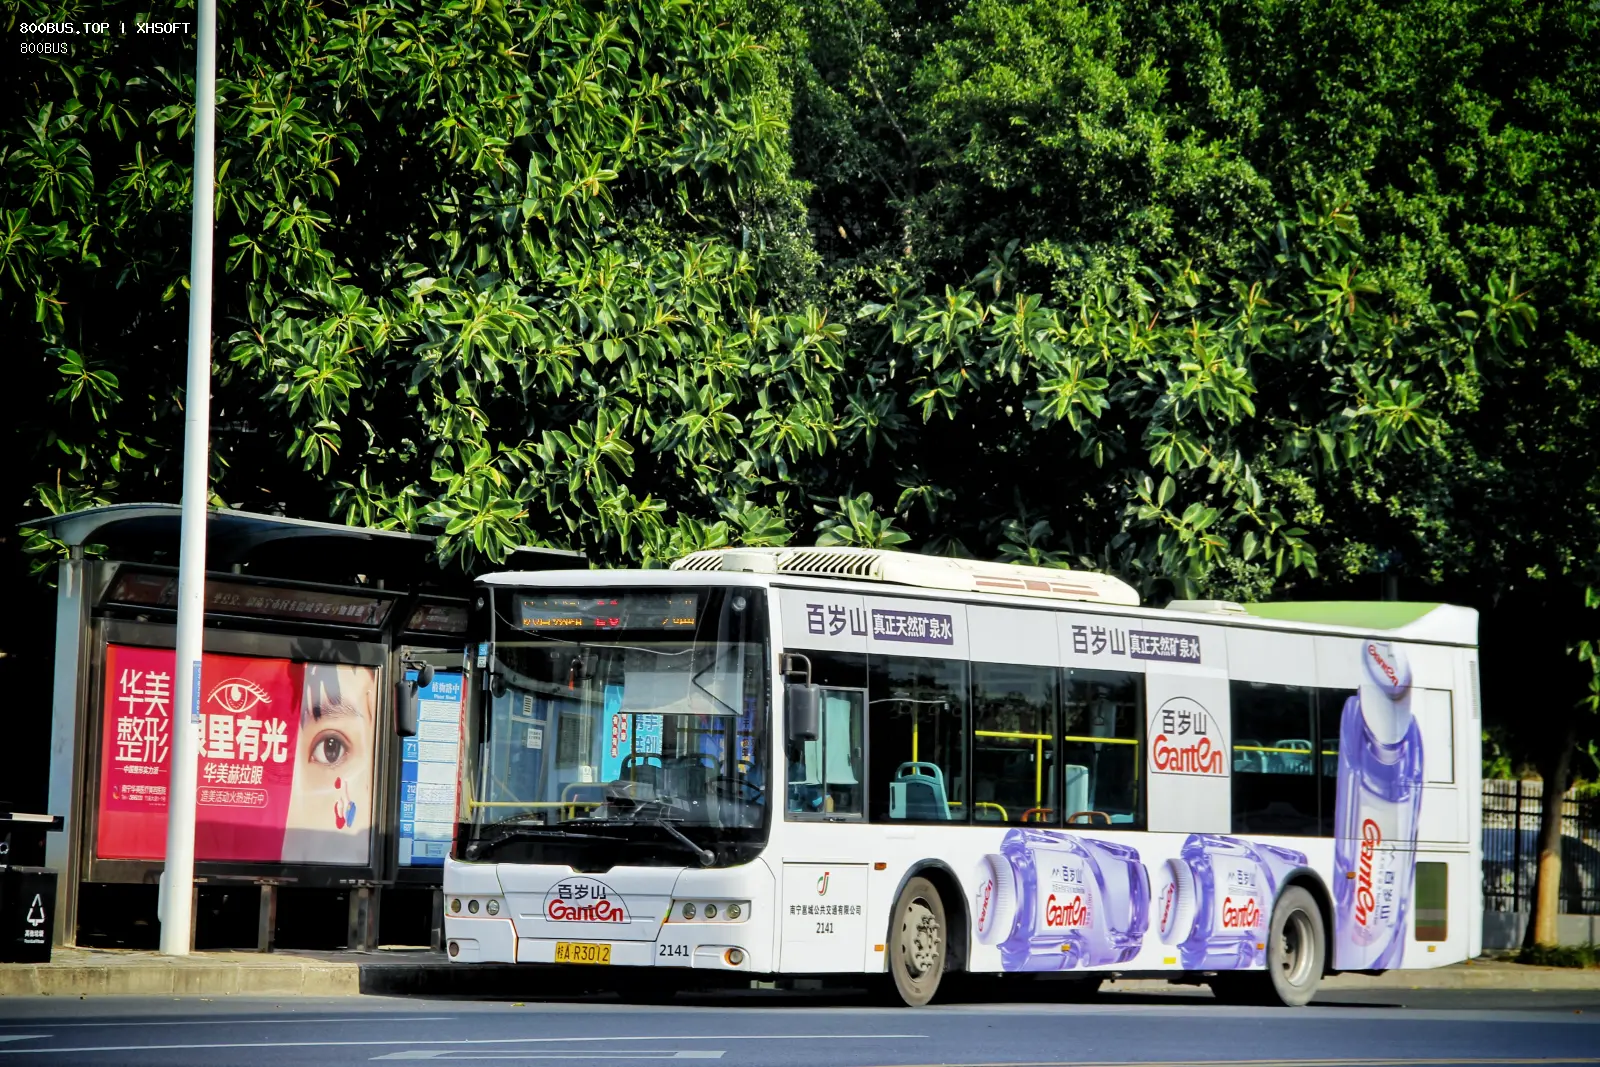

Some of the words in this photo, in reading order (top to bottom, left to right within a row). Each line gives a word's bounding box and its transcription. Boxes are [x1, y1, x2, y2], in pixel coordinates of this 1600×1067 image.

[806, 603, 869, 637] 百岁山
[873, 613, 953, 640] 真正天然矿泉水
[1071, 624, 1127, 656] 百岁山
[1130, 634, 1200, 659] 真正天然矿泉水
[118, 668, 171, 717] 华美
[1162, 709, 1207, 736] 百岁山
[114, 715, 170, 764] 整形
[407, 743, 417, 752] 71
[1153, 734, 1223, 774] Ganten
[203, 762, 264, 785] 华美赫拉眼
[1356, 818, 1382, 926] Ganten
[558, 884, 607, 900] 百岁山
[548, 899, 624, 922] Ganten
[1046, 893, 1087, 927] Ganten
[1222, 896, 1260, 928] Ganten
[816, 922, 834, 934] 2141
[659, 944, 690, 957] 2141
